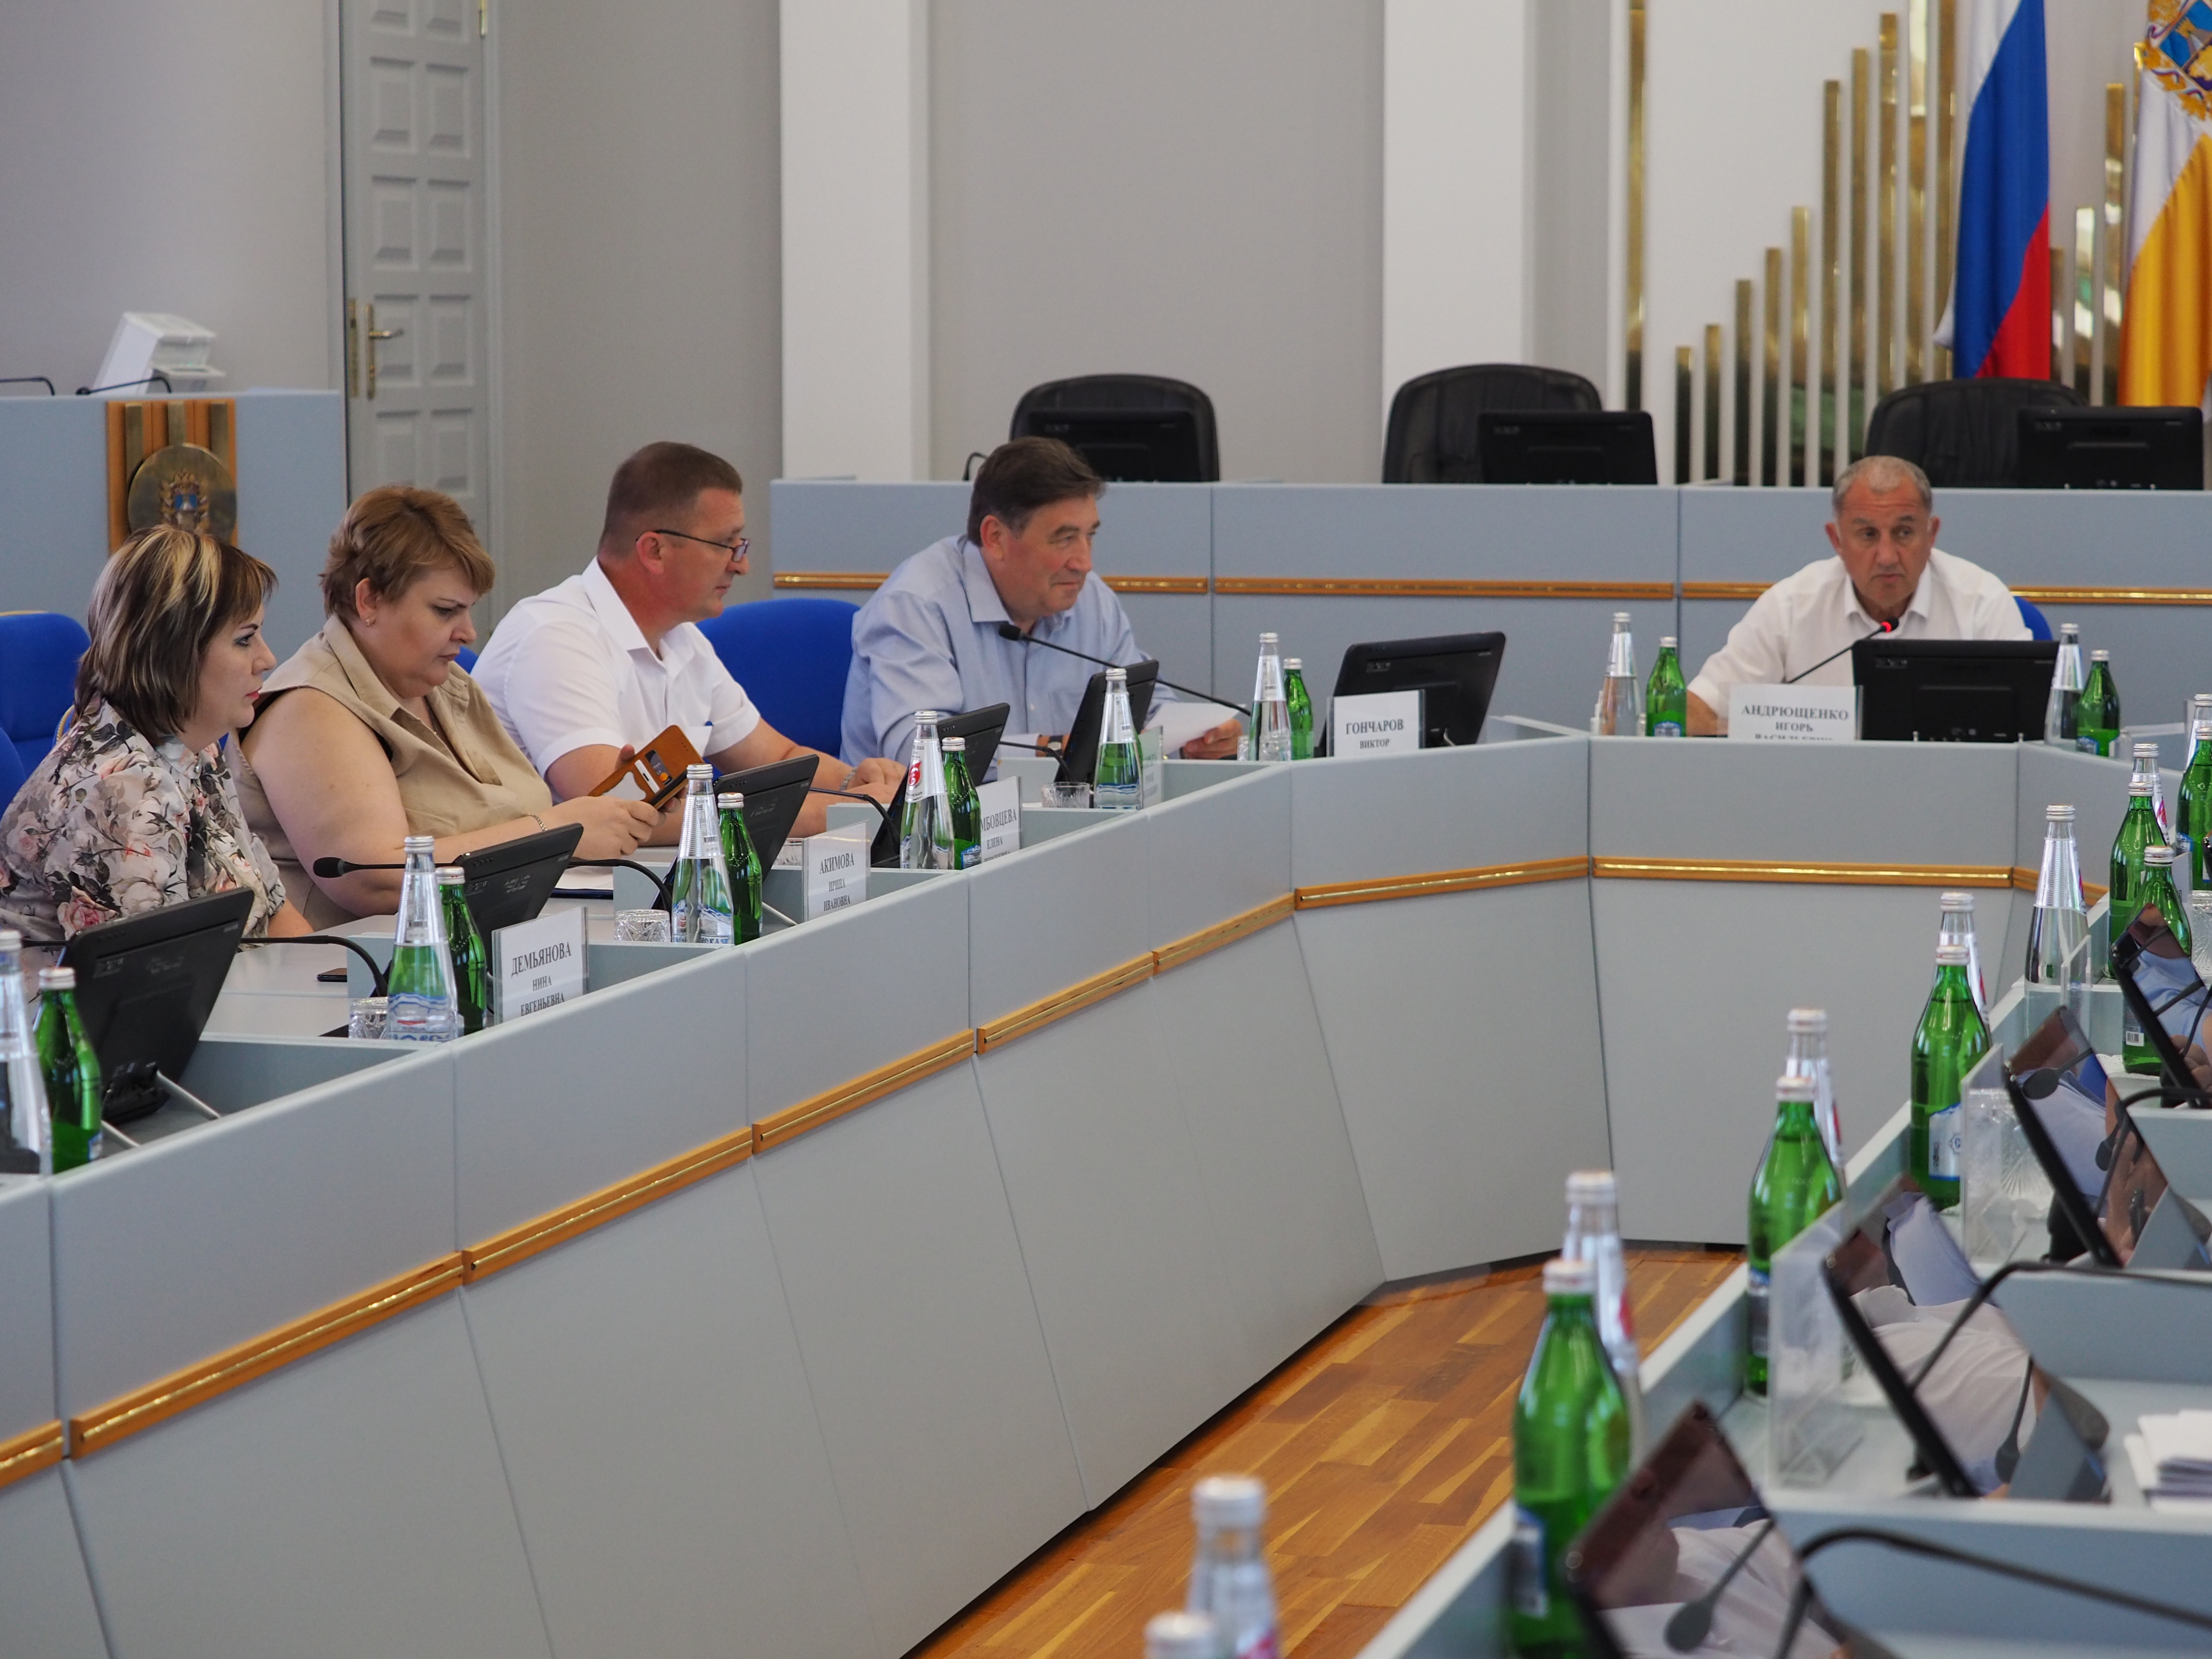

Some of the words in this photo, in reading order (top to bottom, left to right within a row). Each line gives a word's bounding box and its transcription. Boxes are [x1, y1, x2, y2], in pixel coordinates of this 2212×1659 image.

[1741, 704, 1849, 720] АНДРЮЩЕНКО
[1346, 719, 1405, 735] ГОНЧАРОВ
[1775, 721, 1814, 732] ИГОРЬ
[1359, 738, 1390, 749] ВИКТОР
[986, 836, 1003, 850] ЕЛЕНА
[819, 852, 854, 875] АКИМОВА
[828, 878, 846, 892] ИРИНА
[823, 895, 851, 912] ИВАНОВНА
[511, 941, 572, 978] ДЕМЬЯНОВА
[532, 975, 552, 991] НИНА
[520, 991, 565, 1017] ЕВГЕНЬЕВНА
